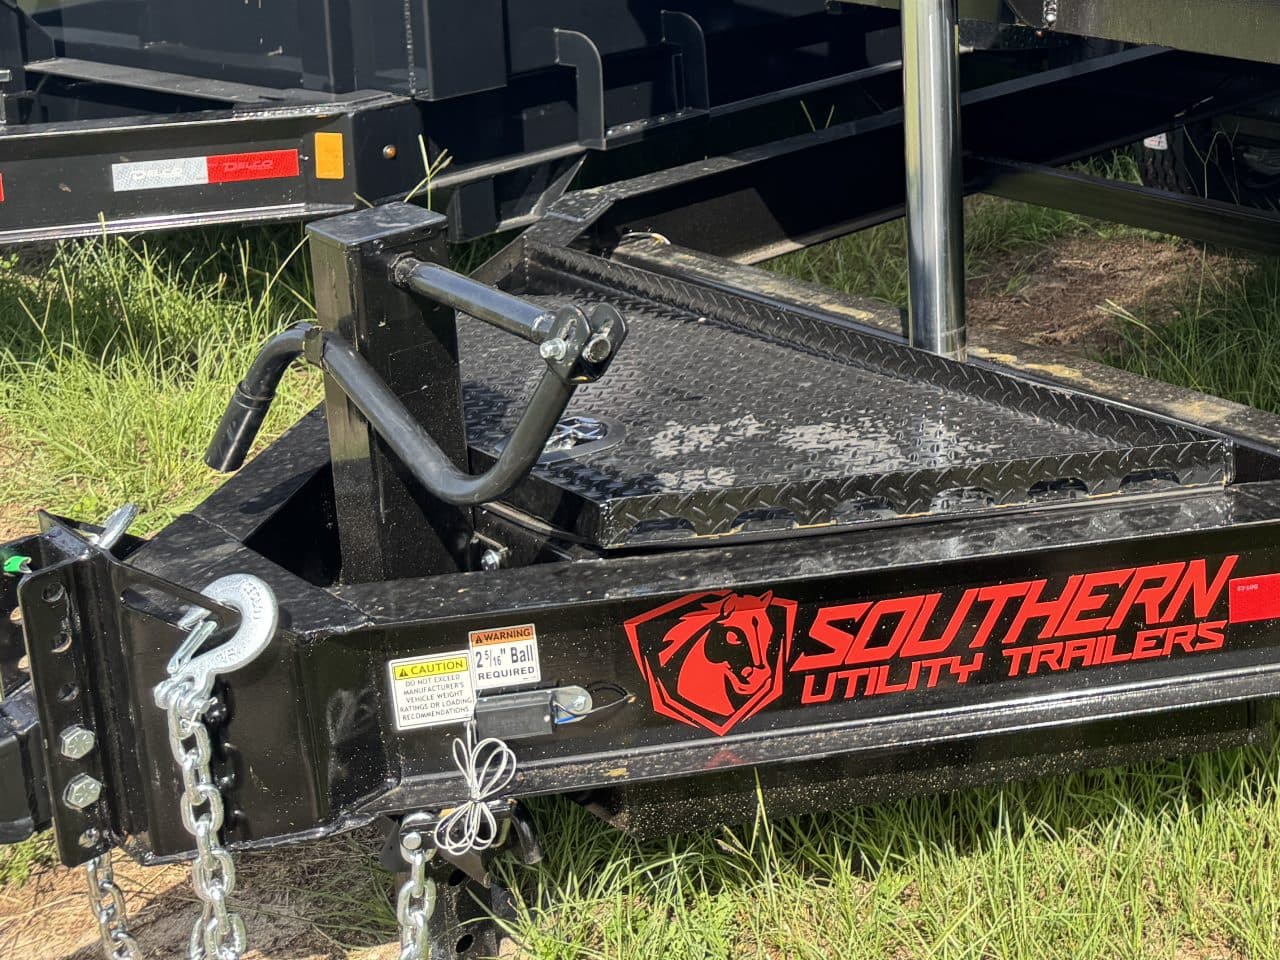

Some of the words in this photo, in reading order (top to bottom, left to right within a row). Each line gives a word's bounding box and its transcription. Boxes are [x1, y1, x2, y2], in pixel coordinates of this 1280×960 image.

[223, 159, 274, 172] DELCO
[789, 554, 1240, 672] SOUTHERN
[484, 628, 531, 641] WARNING
[510, 644, 534, 664] Ball
[410, 659, 463, 675] CAUTION
[800, 652, 984, 704] UTILITY
[1002, 620, 1228, 677] TRAILERS
[434, 674, 460, 683] EXCEED
[478, 666, 535, 680] REQUIRED
[406, 694, 435, 703] VEHICLE
[436, 690, 464, 699] WEIGHT
[400, 703, 429, 712] RATINGS
[442, 697, 472, 707] LOADING
[402, 707, 470, 720] RECOMMENDATIONS
